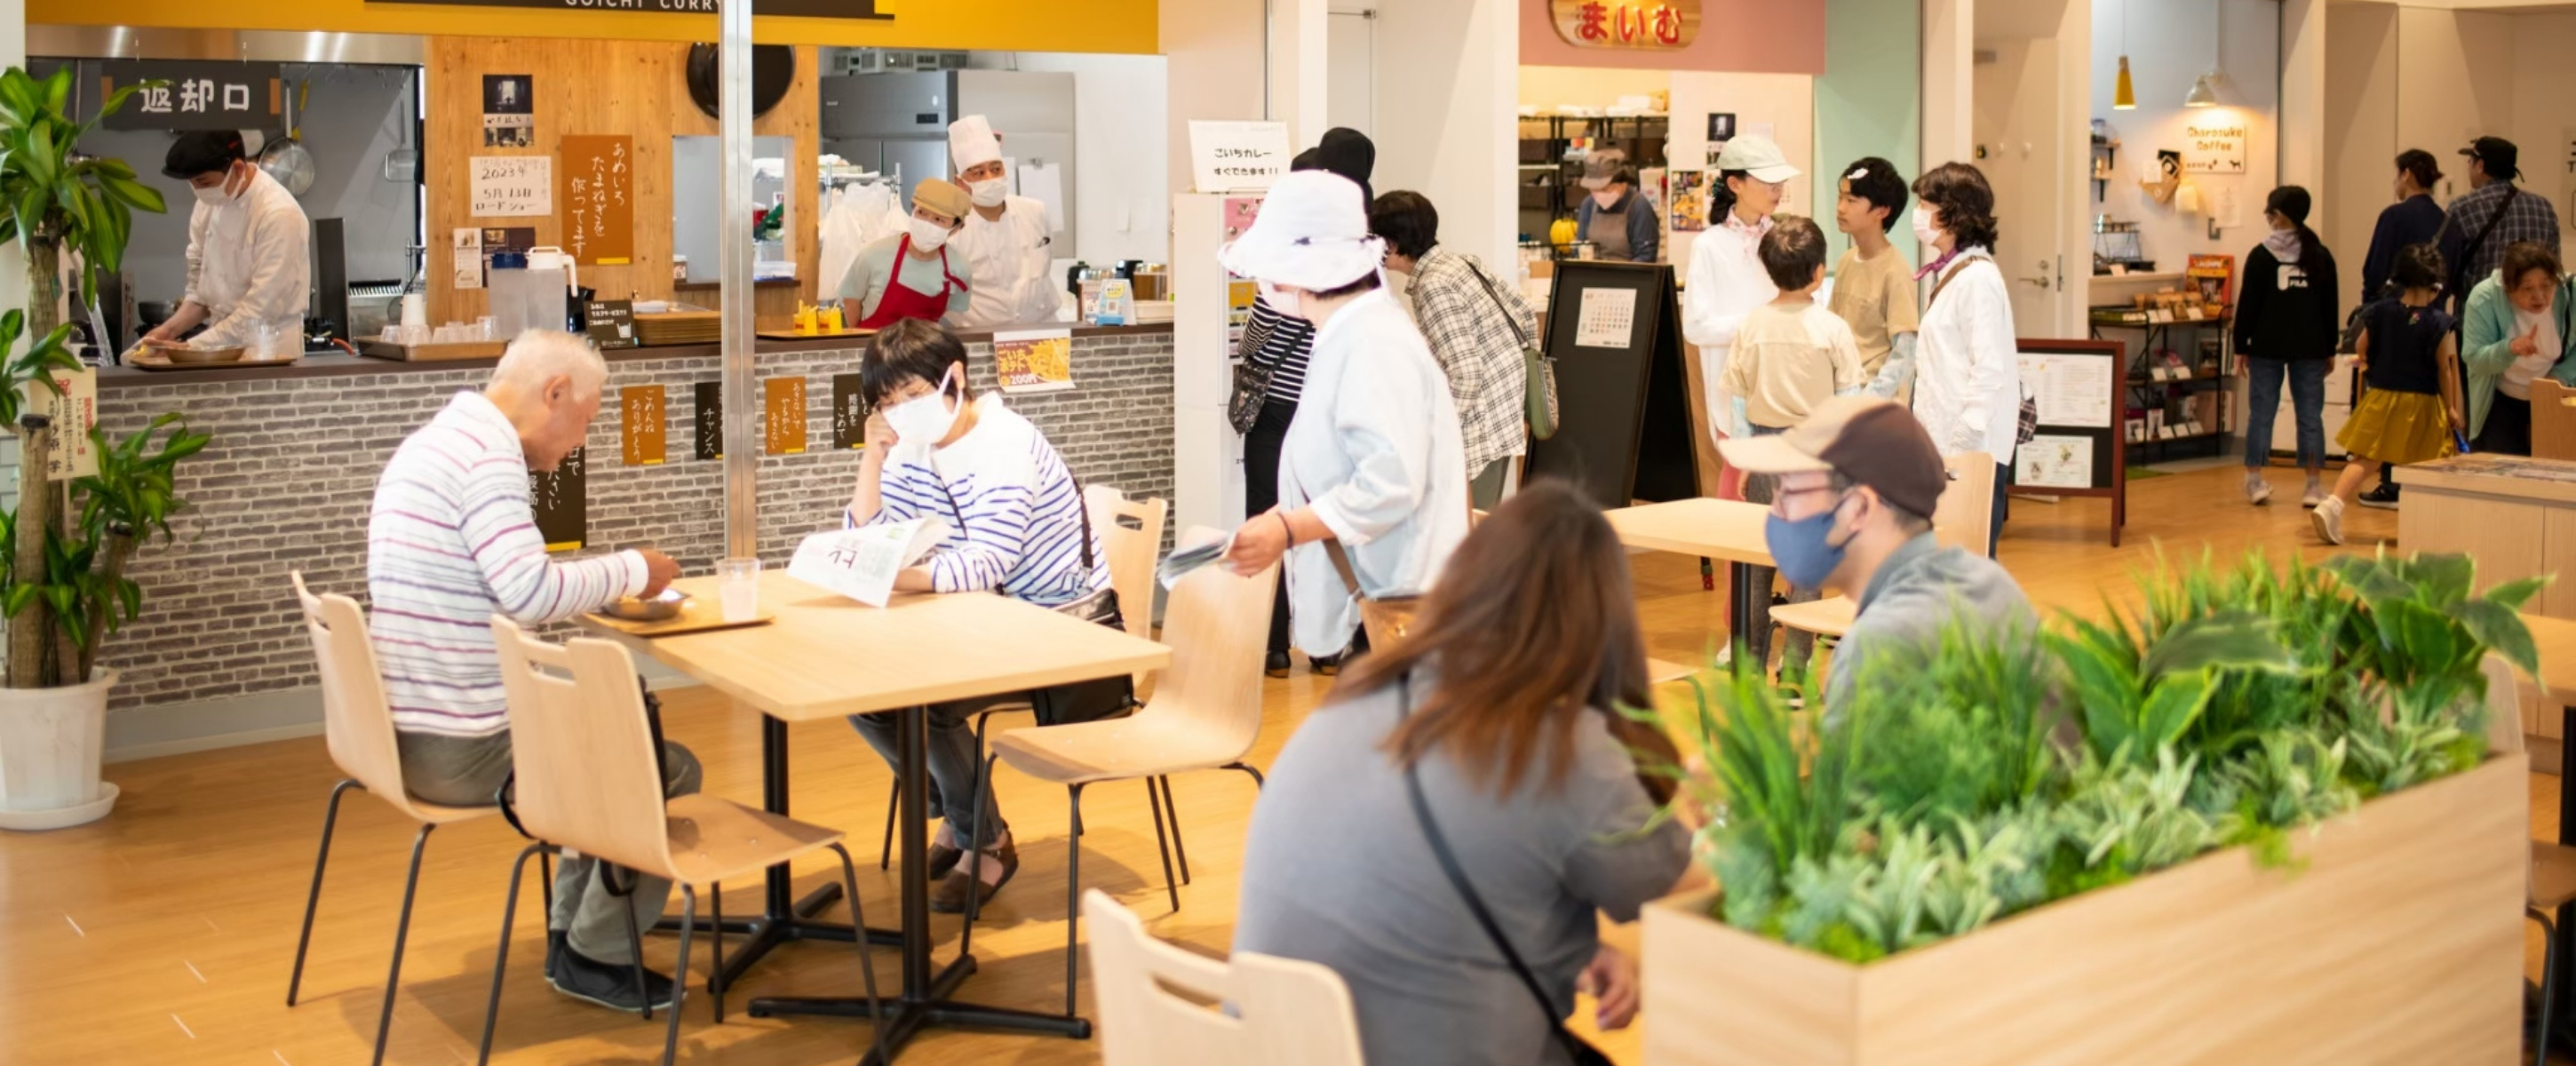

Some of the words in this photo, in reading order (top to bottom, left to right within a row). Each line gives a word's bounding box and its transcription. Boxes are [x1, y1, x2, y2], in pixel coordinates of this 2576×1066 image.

[660, 0, 720, 10] CURR
[1578, 1, 1682, 44] まいむ
[139, 78, 250, 113] 返却口
[2197, 140, 2232, 151] Coffee
[591, 155, 607, 237] たまねぎを
[612, 142, 626, 206] あめいろ
[571, 177, 586, 258] 作ってます
[2289, 279, 2308, 288] FILA
[1009, 374, 1038, 385] 200円
[631, 399, 641, 461] ありがとう
[644, 389, 655, 434] ごめんね
[703, 408, 715, 454] チャンス
